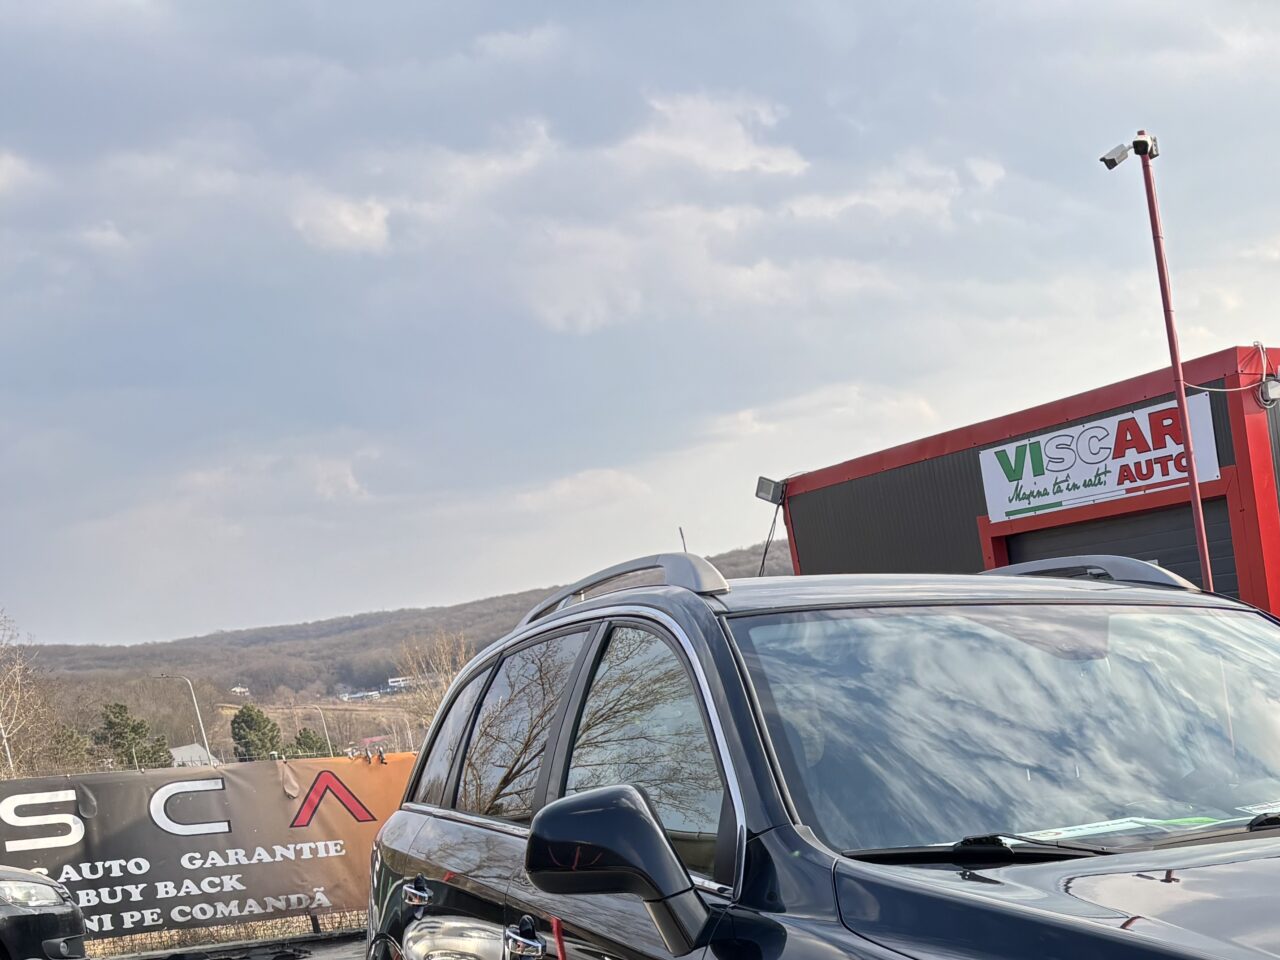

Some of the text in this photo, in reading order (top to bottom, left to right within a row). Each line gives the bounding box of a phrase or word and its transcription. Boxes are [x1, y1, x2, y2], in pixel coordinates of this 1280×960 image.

[994, 407, 1185, 482] VISCAR
[57, 839, 346, 883] AUTO GARANTIE
[77, 874, 246, 907] BUY BACK
[120, 908, 163, 929] PE
